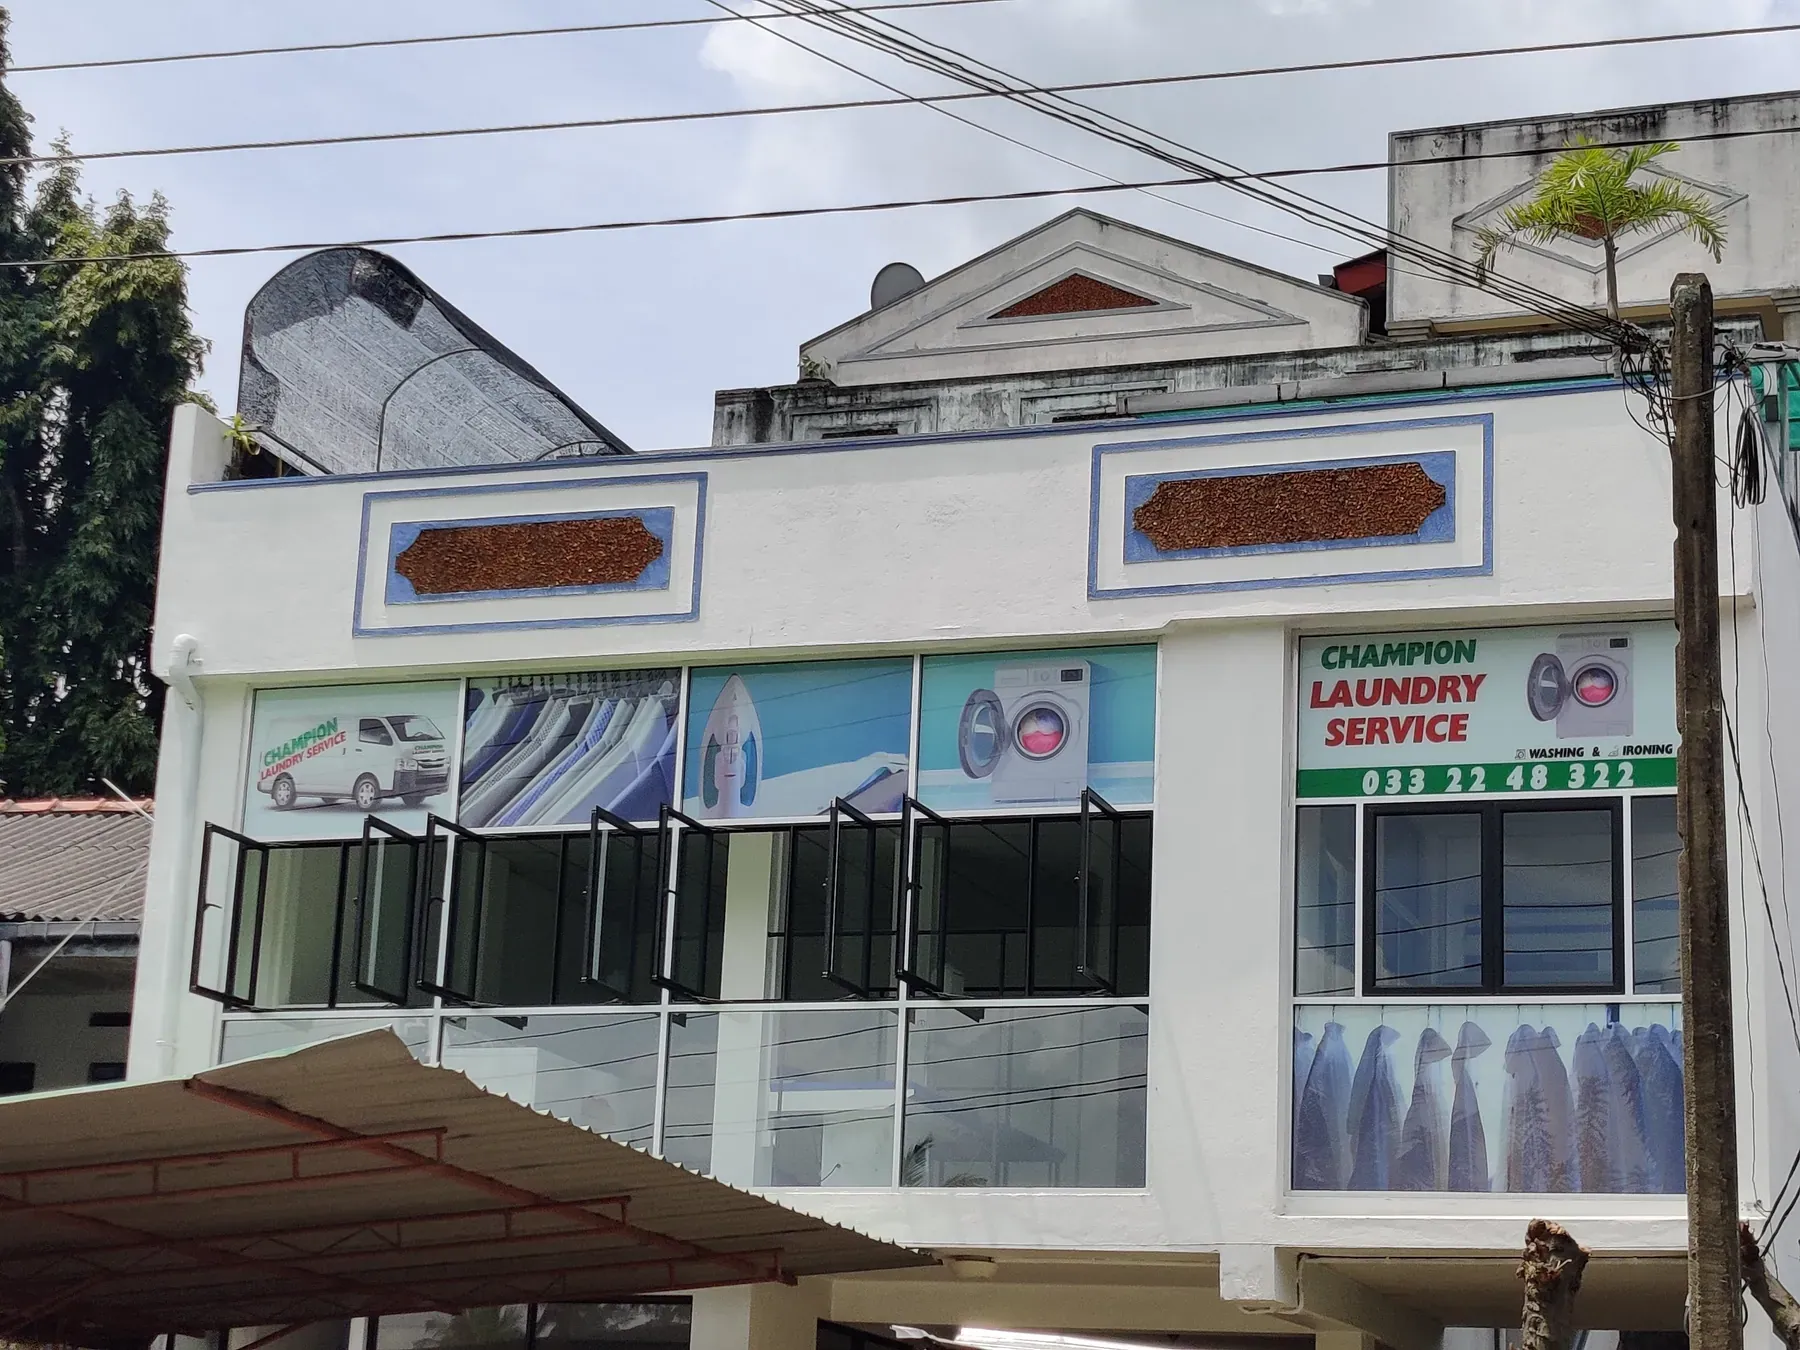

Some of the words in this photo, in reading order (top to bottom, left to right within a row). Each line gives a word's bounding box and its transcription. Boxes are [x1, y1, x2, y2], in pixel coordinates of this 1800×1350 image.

[1321, 638, 1477, 670] CHAMPION
[1310, 673, 1487, 709] LAUNDRY
[264, 716, 339, 767] CHAMPION
[1324, 713, 1469, 747] SERVICE
[260, 751, 305, 780] LAUNDRY
[306, 730, 347, 759] SERVICE
[1529, 747, 1585, 758] WASHING
[1592, 746, 1601, 757] &
[1622, 744, 1673, 756] IRONING
[1361, 768, 1425, 795] 033
[1444, 765, 1486, 792] 22
[1505, 764, 1548, 791] 48
[1567, 761, 1634, 789] 322
